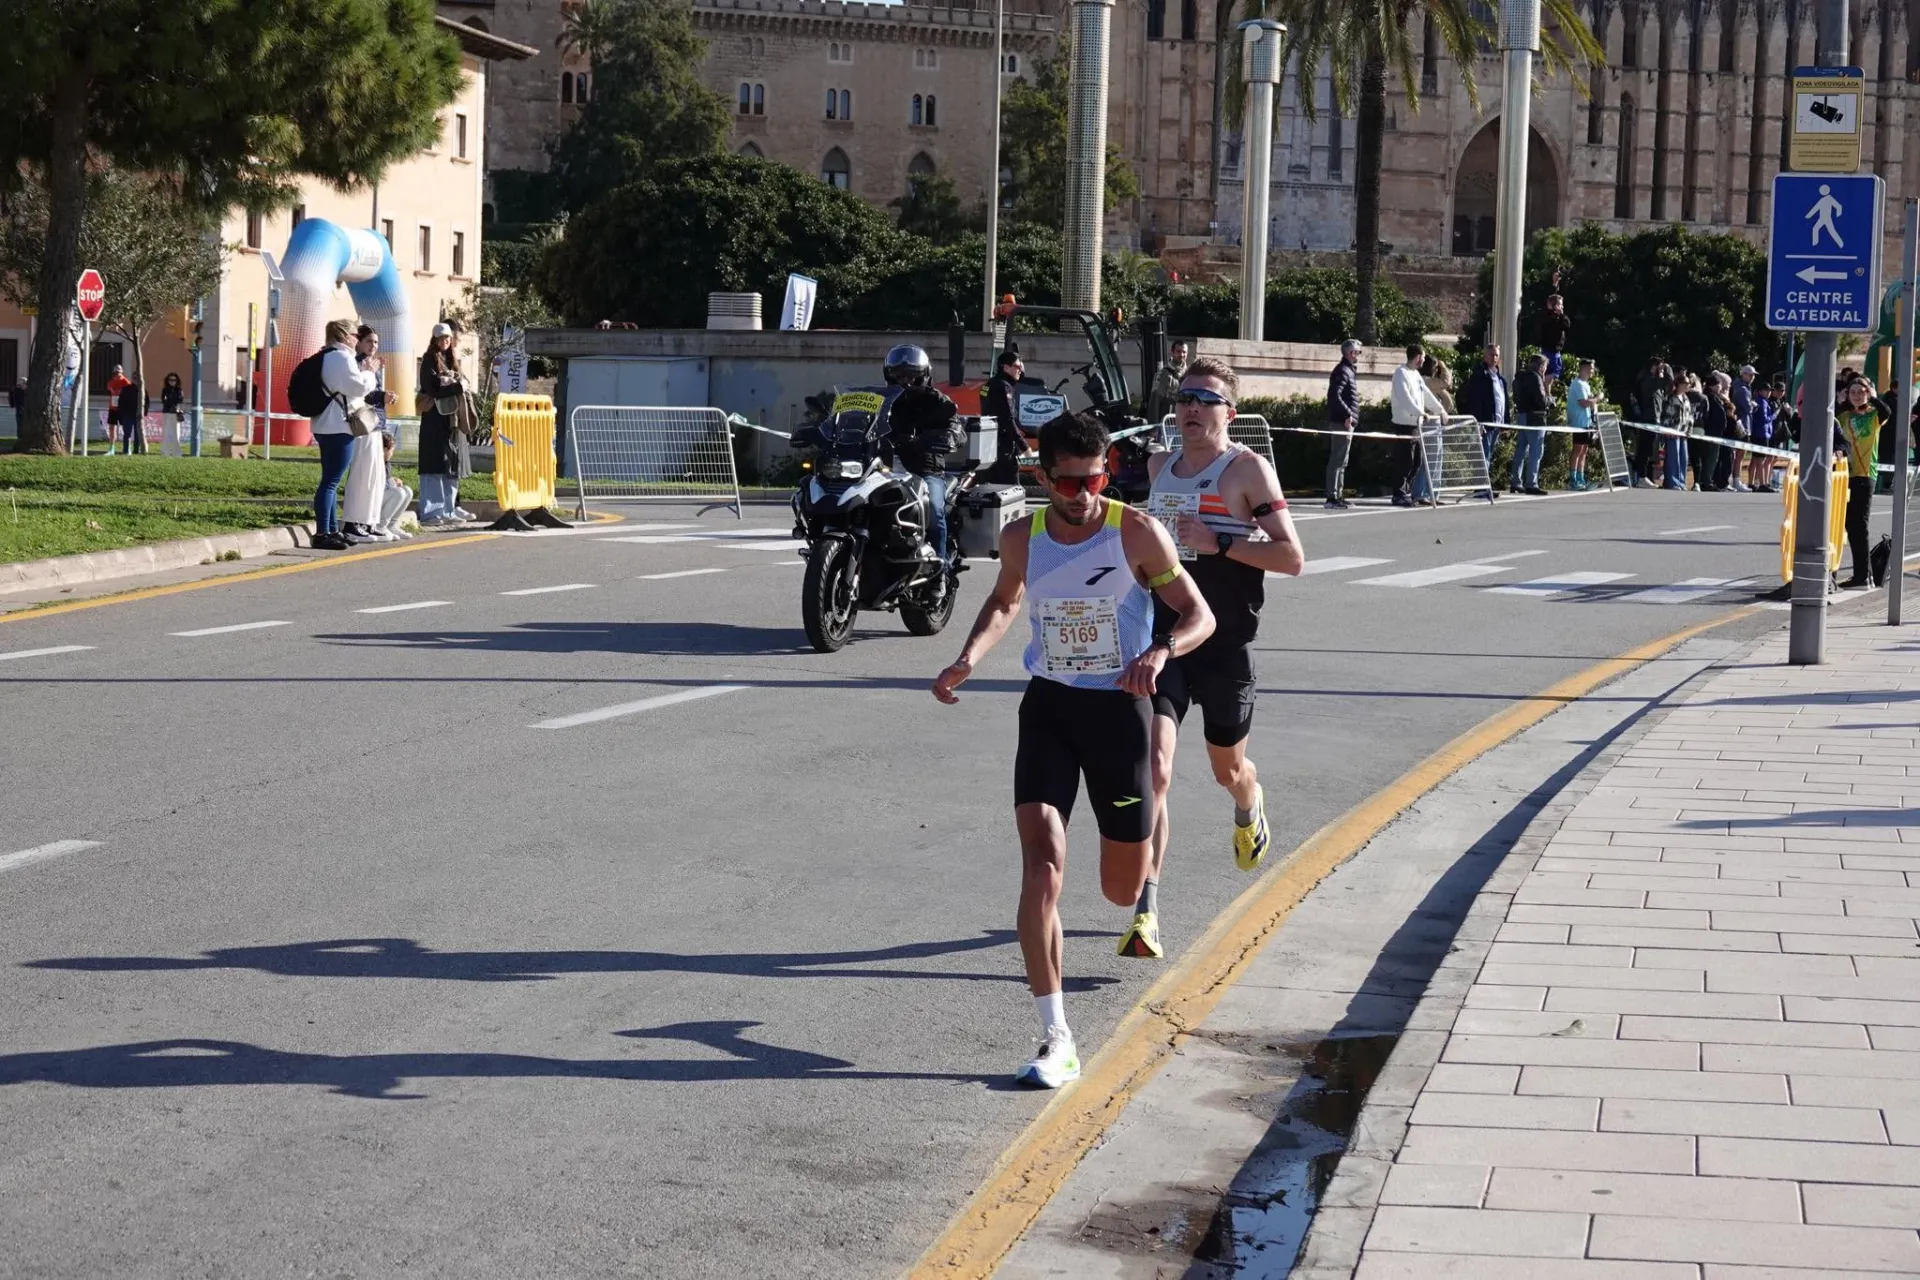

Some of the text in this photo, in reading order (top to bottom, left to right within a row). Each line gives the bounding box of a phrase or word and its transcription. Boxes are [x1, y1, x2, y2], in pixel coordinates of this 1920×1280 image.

[80, 289, 104, 301] STOP
[1786, 291, 1853, 304] CENTRE
[1774, 308, 1862, 322] CATEDRAL
[836, 400, 878, 410] AUTORIZADO
[1059, 626, 1098, 644] 5169
